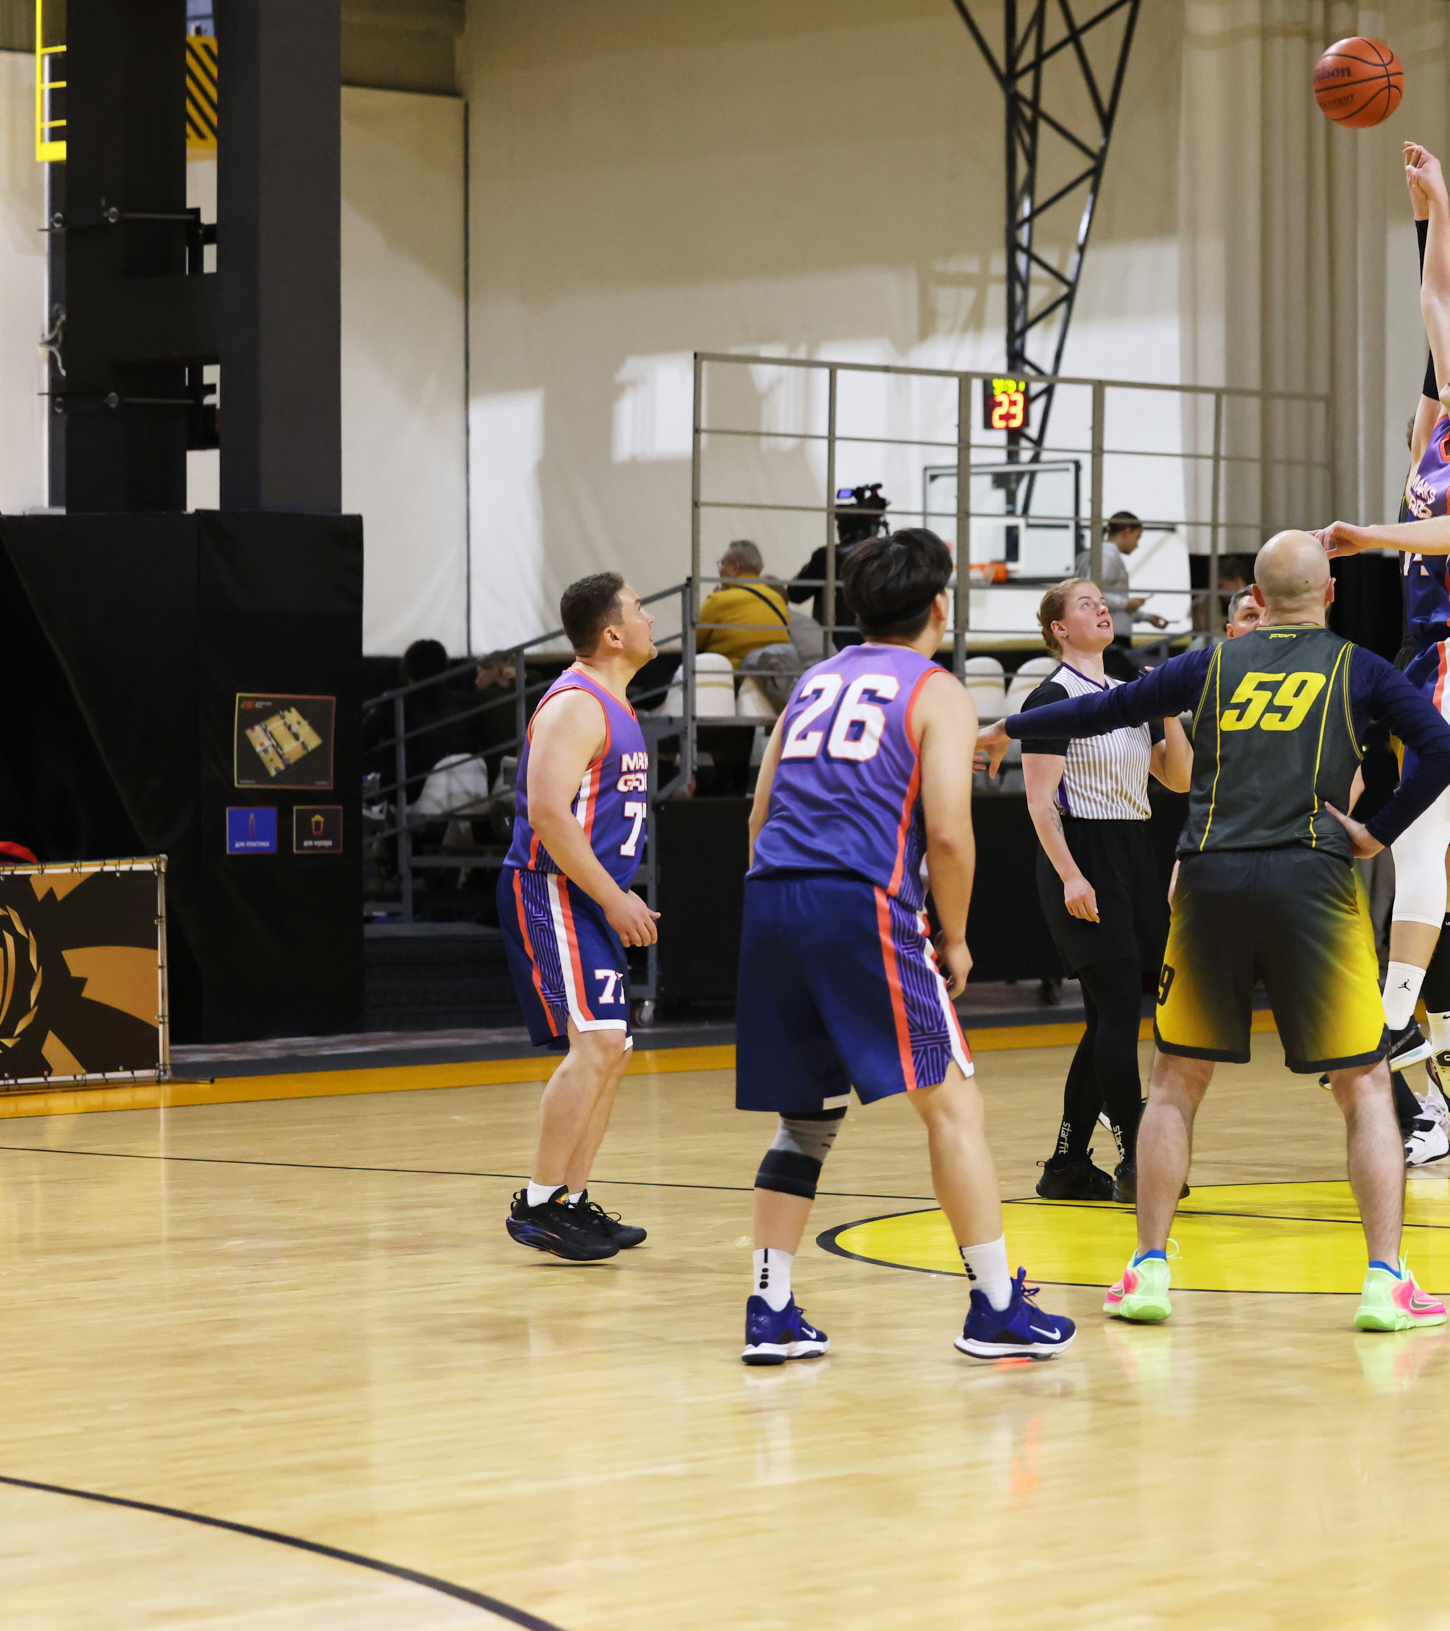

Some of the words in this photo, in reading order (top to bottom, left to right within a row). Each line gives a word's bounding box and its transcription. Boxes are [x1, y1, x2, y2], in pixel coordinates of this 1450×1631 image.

[992, 391, 1025, 429] 23
[780, 672, 901, 764] 26
[1220, 671, 1327, 732] 59
[620, 801, 647, 857] 7
